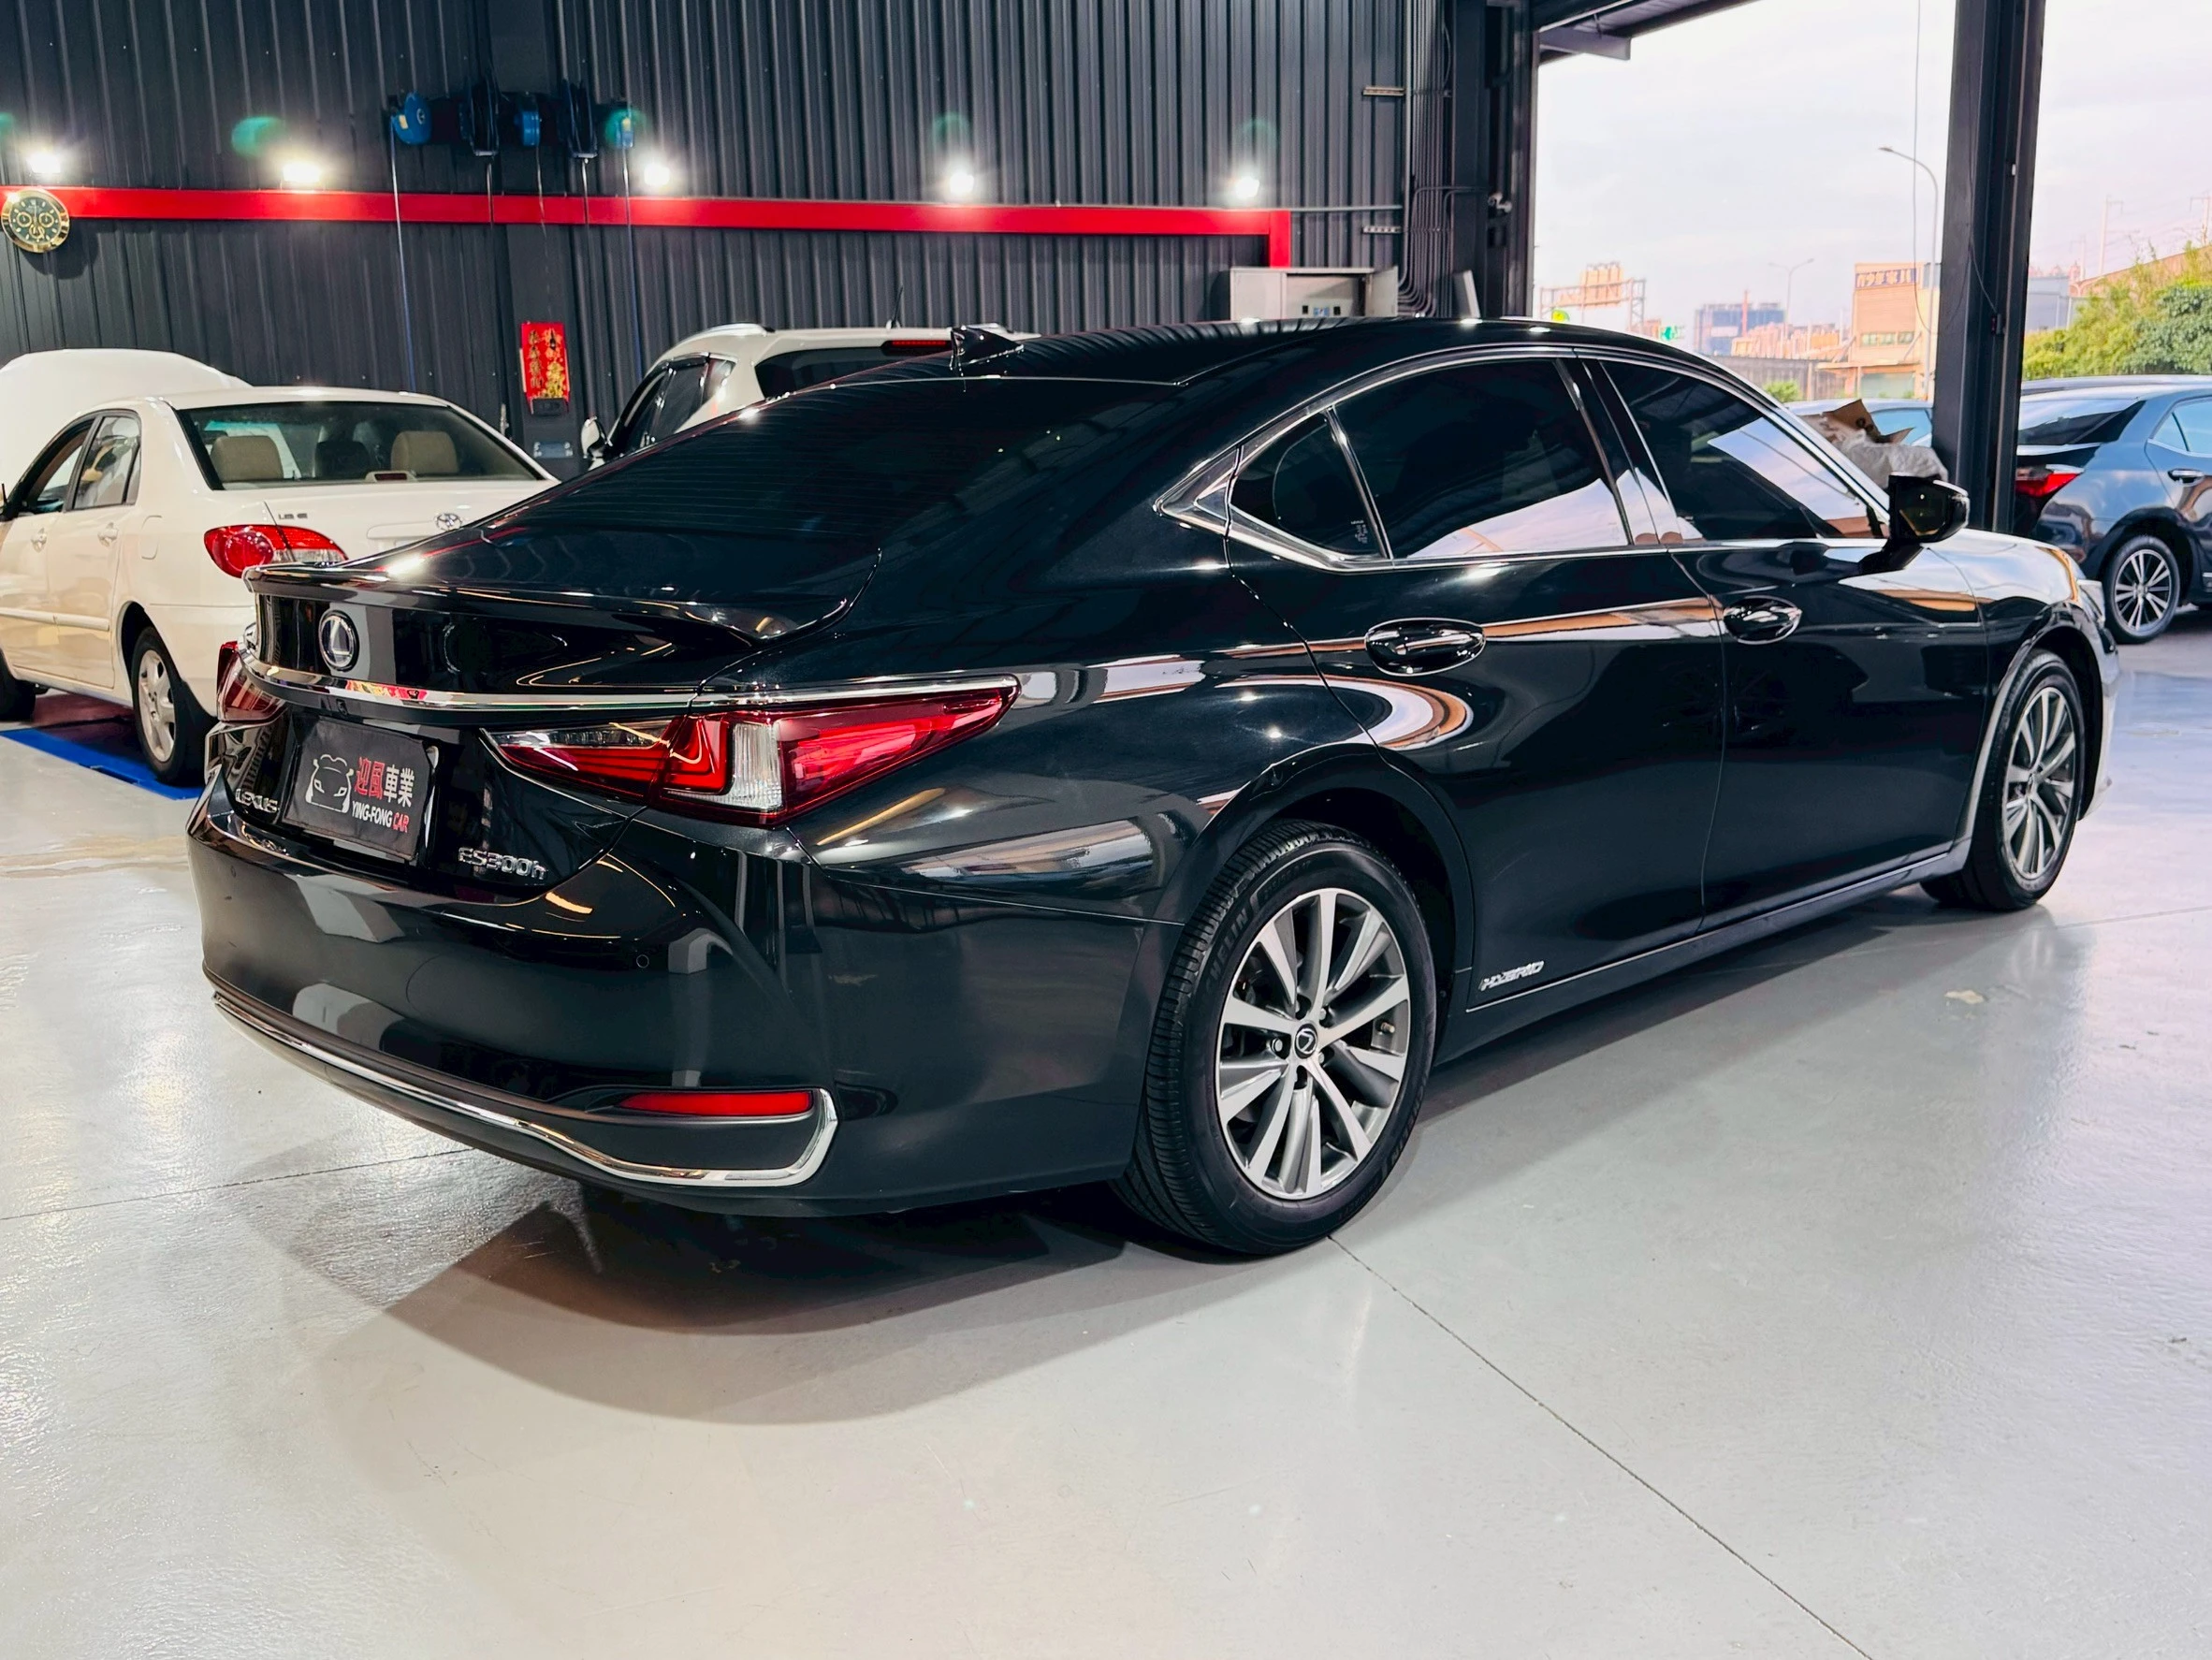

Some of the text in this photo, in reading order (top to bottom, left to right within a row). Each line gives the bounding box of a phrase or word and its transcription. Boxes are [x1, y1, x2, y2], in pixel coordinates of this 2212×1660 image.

[235, 788, 278, 813] LEXUS
[352, 800, 410, 833] YING-FONG CAR
[458, 847, 546, 881] ES300h
